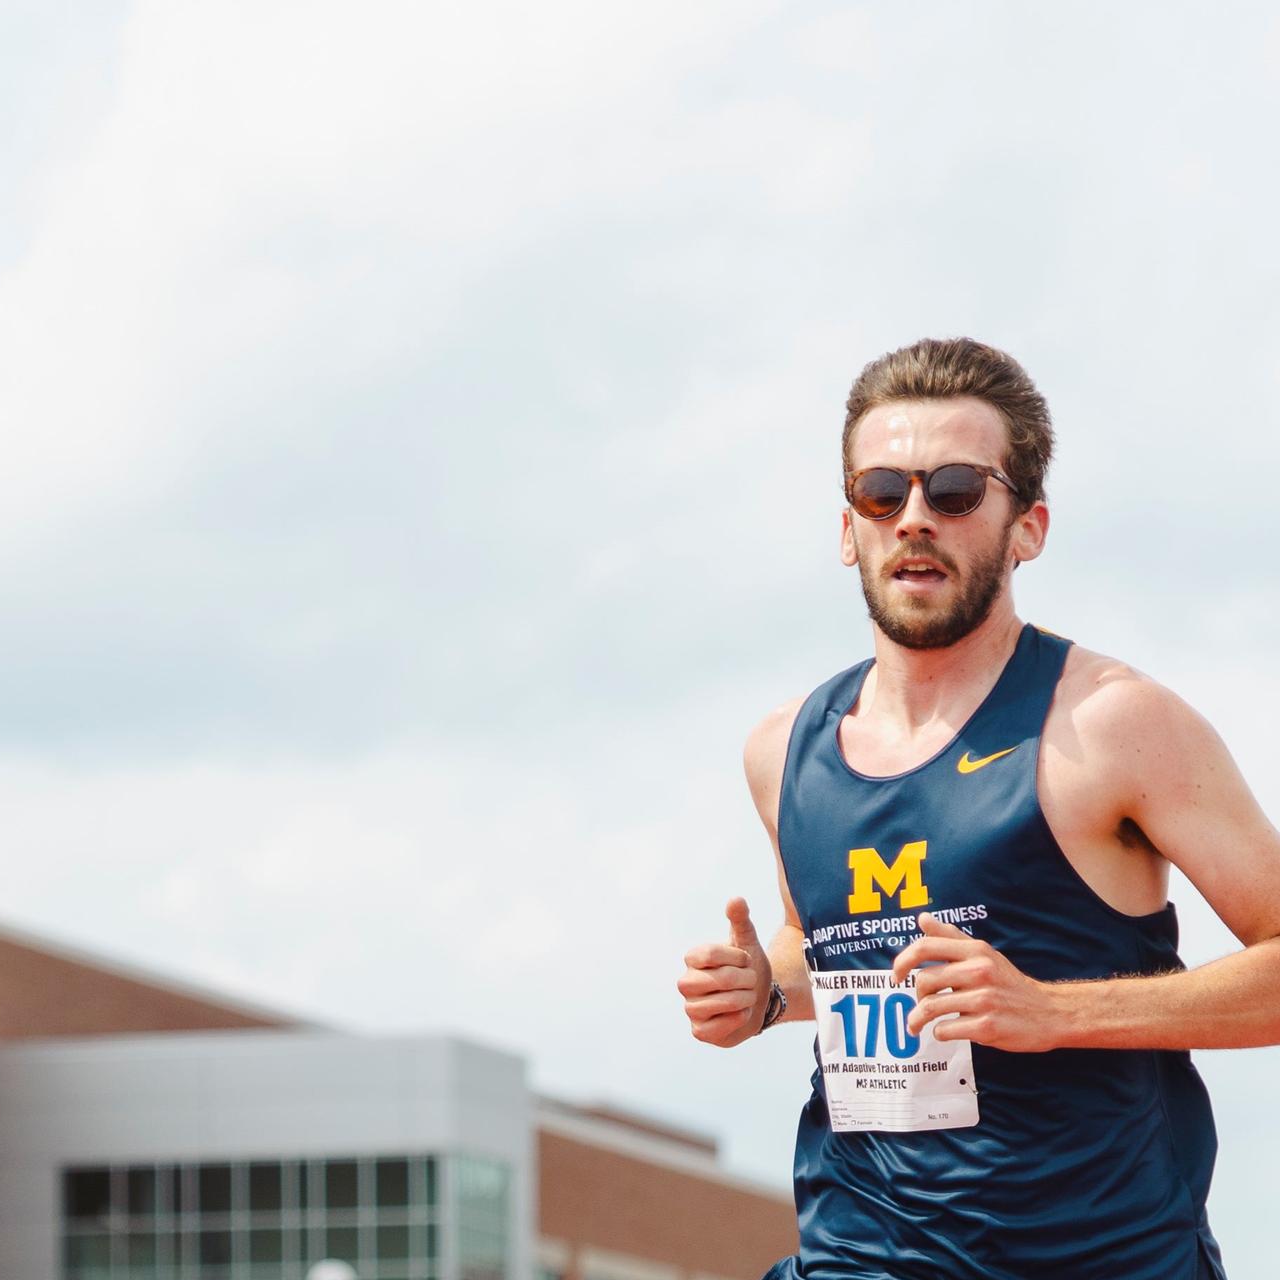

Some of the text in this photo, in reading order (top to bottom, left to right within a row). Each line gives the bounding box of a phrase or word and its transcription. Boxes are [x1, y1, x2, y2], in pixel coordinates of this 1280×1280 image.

[848, 840, 928, 914] M
[862, 916, 917, 935] SPORTS
[931, 904, 988, 925] FITNESS
[824, 935, 906, 957] UNIVERSITY OF
[851, 975, 885, 989] FAMILY
[830, 993, 920, 1059] 170
[842, 1062, 876, 1074] Adaptive
[877, 1063, 900, 1073] Track
[901, 1062, 920, 1073] and
[923, 1061, 948, 1073] Field
[869, 1079, 907, 1090] ATHLETIC
